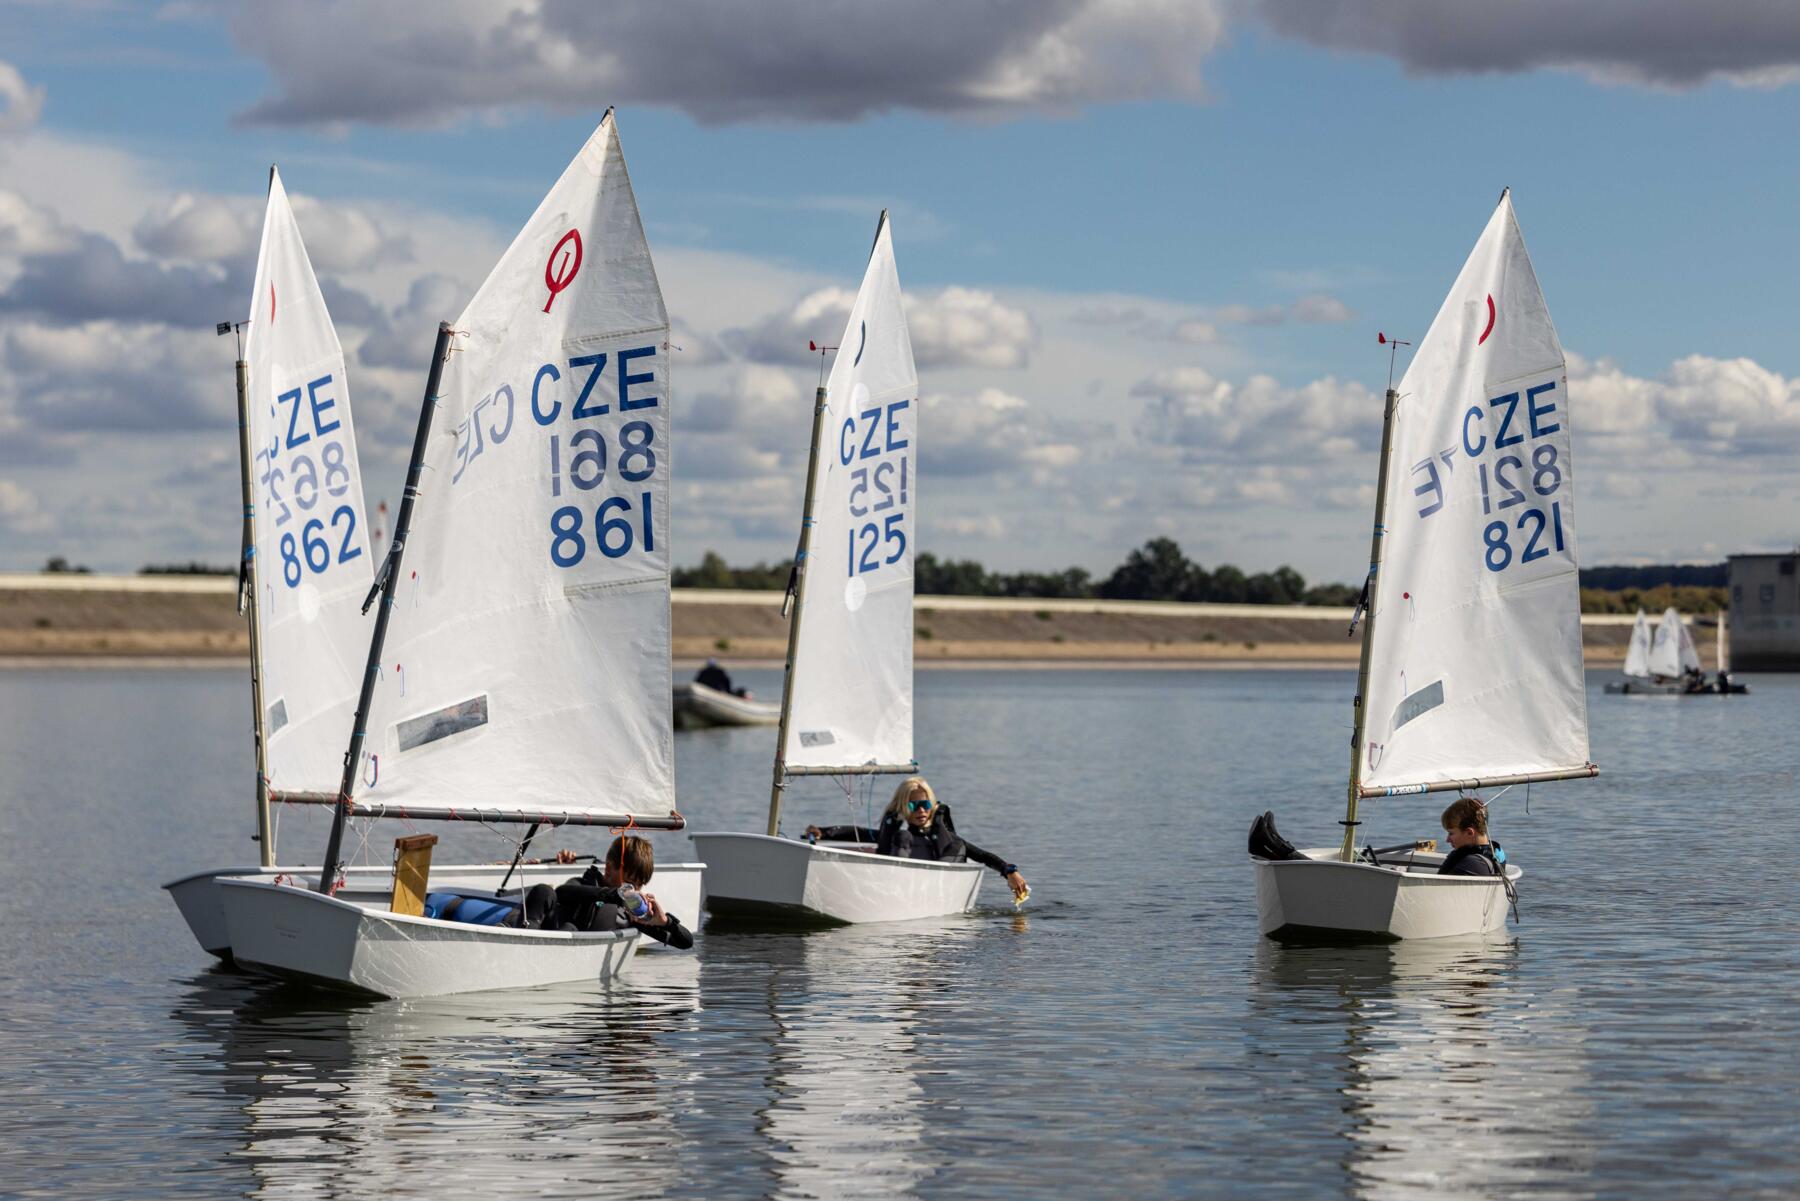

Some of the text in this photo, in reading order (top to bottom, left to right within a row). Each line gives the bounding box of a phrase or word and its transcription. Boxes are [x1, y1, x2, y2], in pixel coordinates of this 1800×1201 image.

[531, 345, 659, 426] CZE
[1462, 381, 1561, 458] CZE
[840, 399, 910, 466] CZE
[279, 504, 362, 589] 862
[550, 491, 655, 568] 861
[848, 512, 907, 578] 125
[1483, 501, 1565, 573] 821
